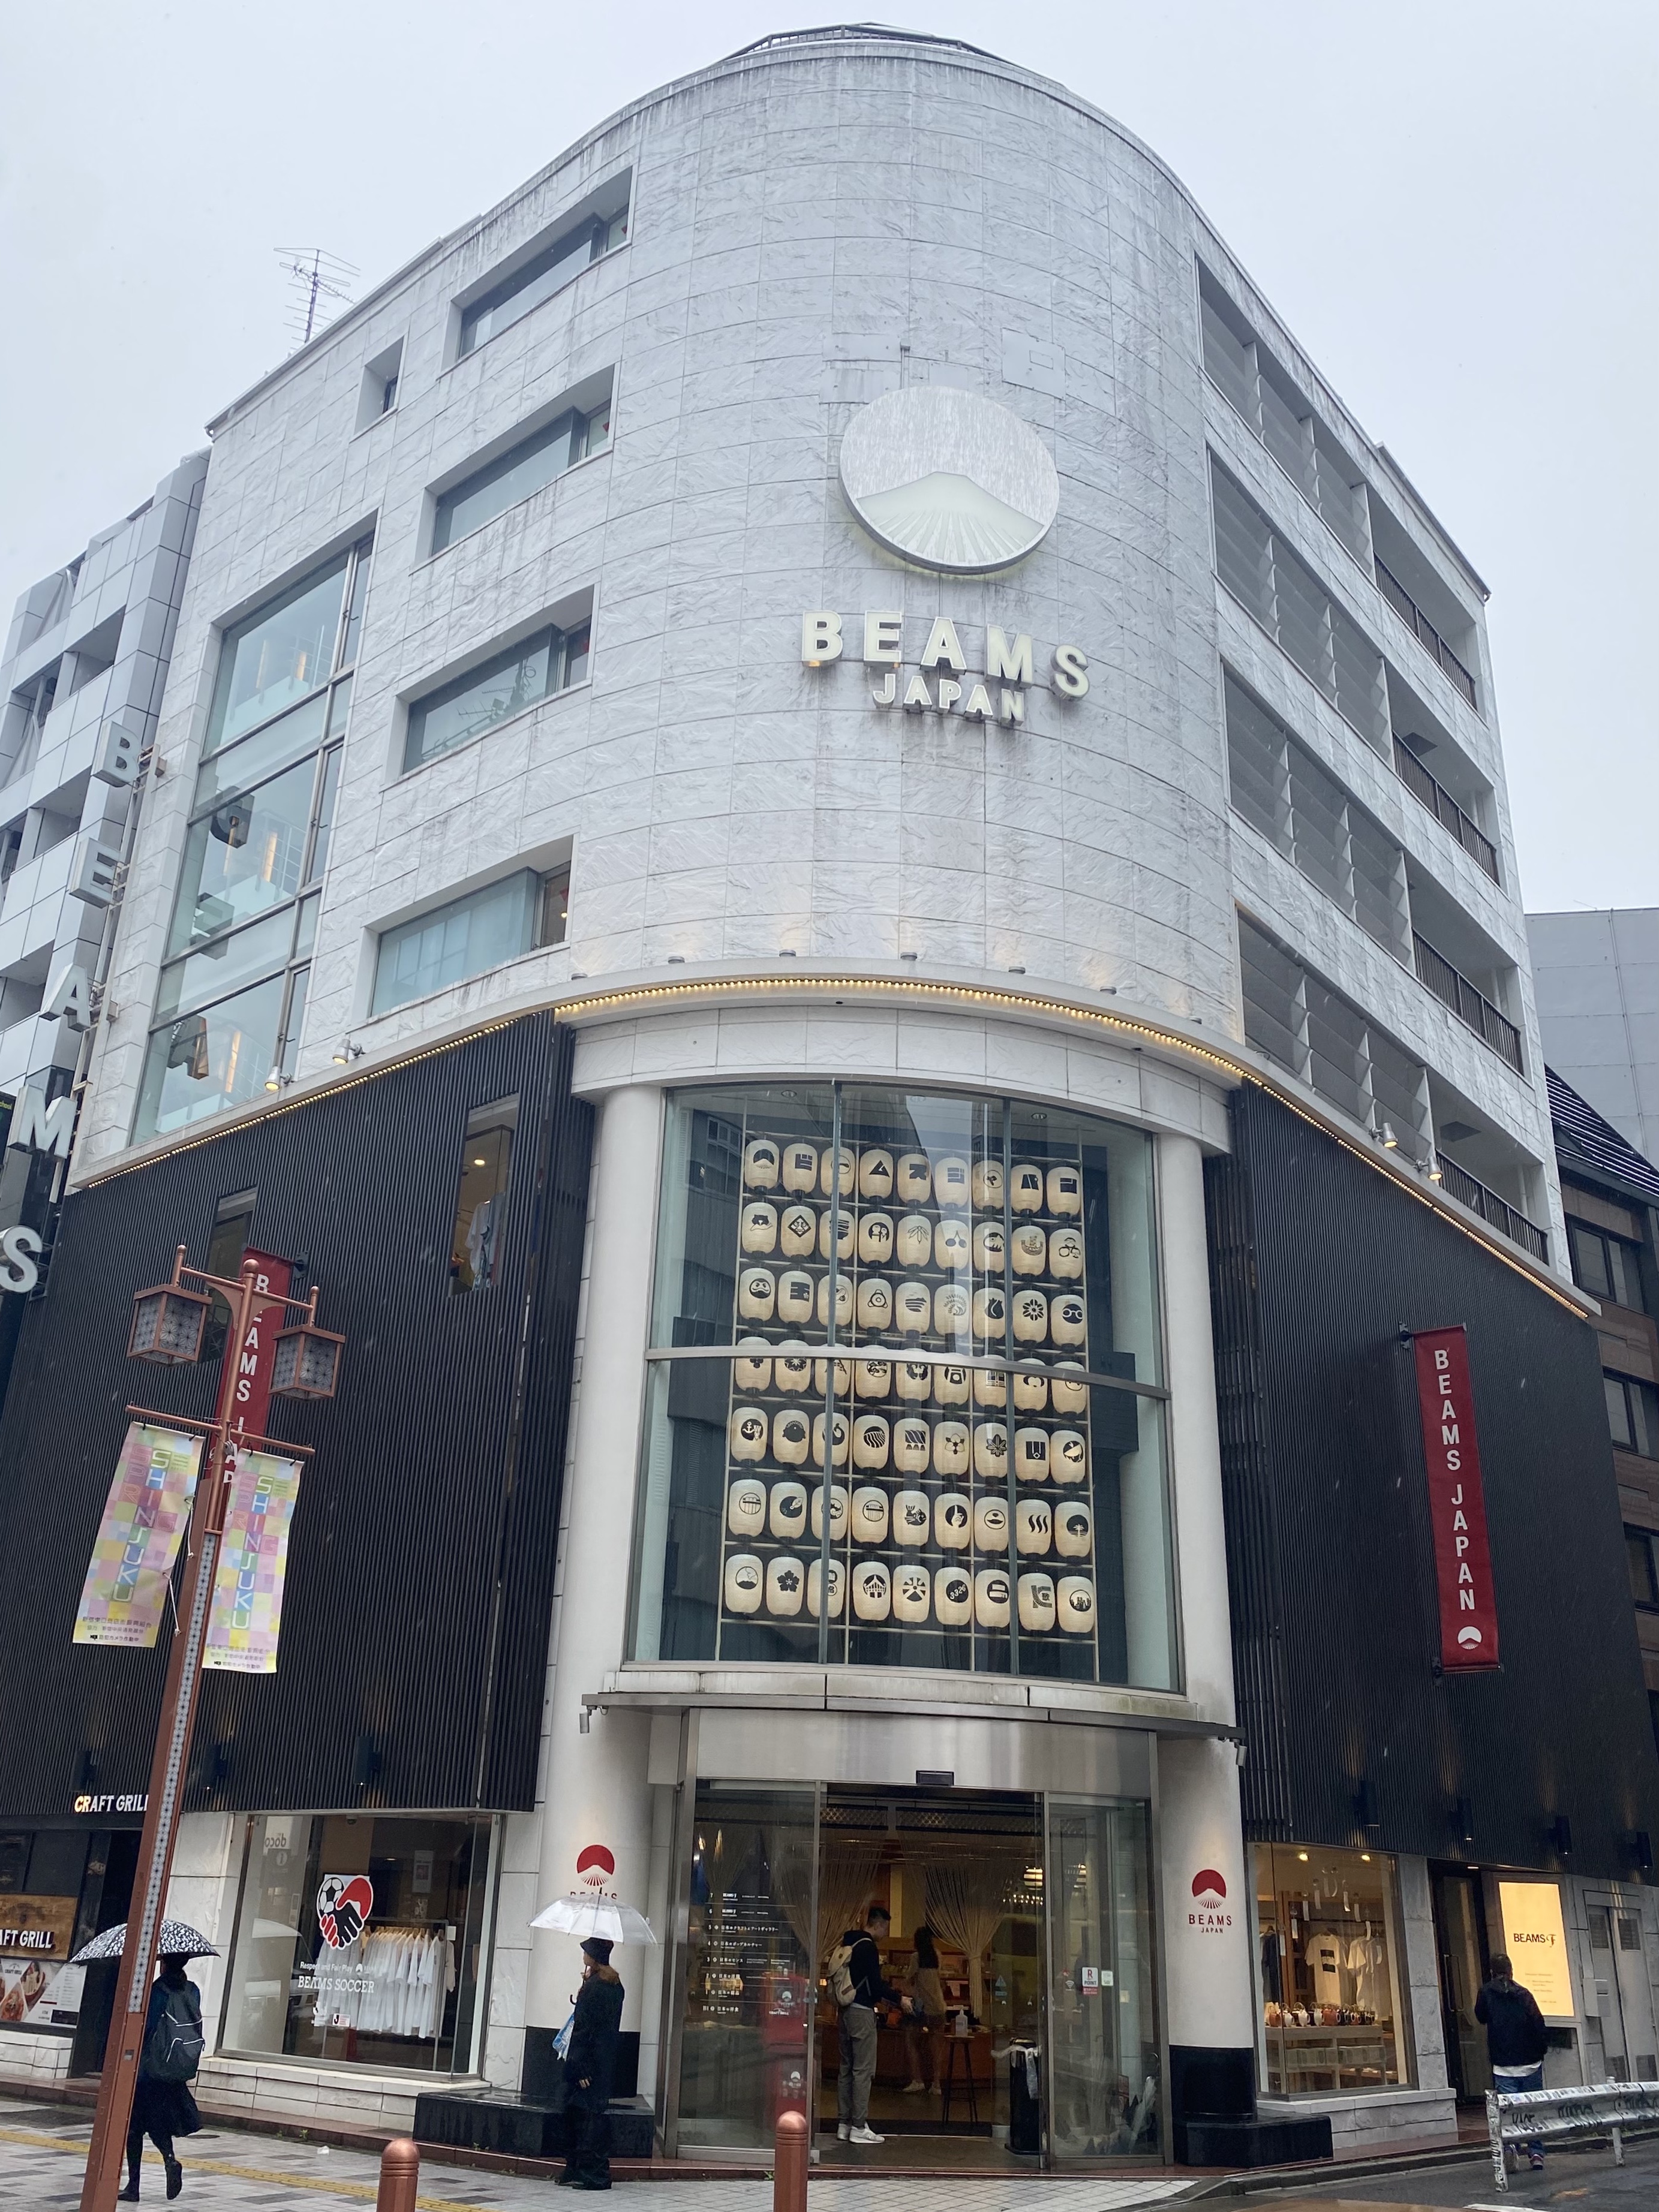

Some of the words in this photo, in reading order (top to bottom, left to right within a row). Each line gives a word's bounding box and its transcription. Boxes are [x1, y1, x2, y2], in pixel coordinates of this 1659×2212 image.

[801, 610, 1090, 700] BEAMS
[873, 673, 1024, 726] JAPAN
[0, 720, 142, 1293] BEAMS
[236, 1274, 270, 1403] BAMS
[1434, 1349, 1462, 1471] BEAMS
[1451, 1484, 1475, 1611] JAPAN
[113, 1449, 172, 1603] SHINJUKU
[232, 1476, 274, 1630] SHINJUKU
[74, 1795, 114, 1812] CRAFT
[1188, 1914, 1232, 1926] BEAMS
[1513, 1933, 1546, 1943] BEAMS
[19, 1930, 53, 1949] GRILL
[297, 1975, 333, 1990] BEAMS
[334, 1979, 375, 1993] SOCCER
[300, 1961, 320, 1971] Respect
[1087, 1969, 1093, 1979] R
